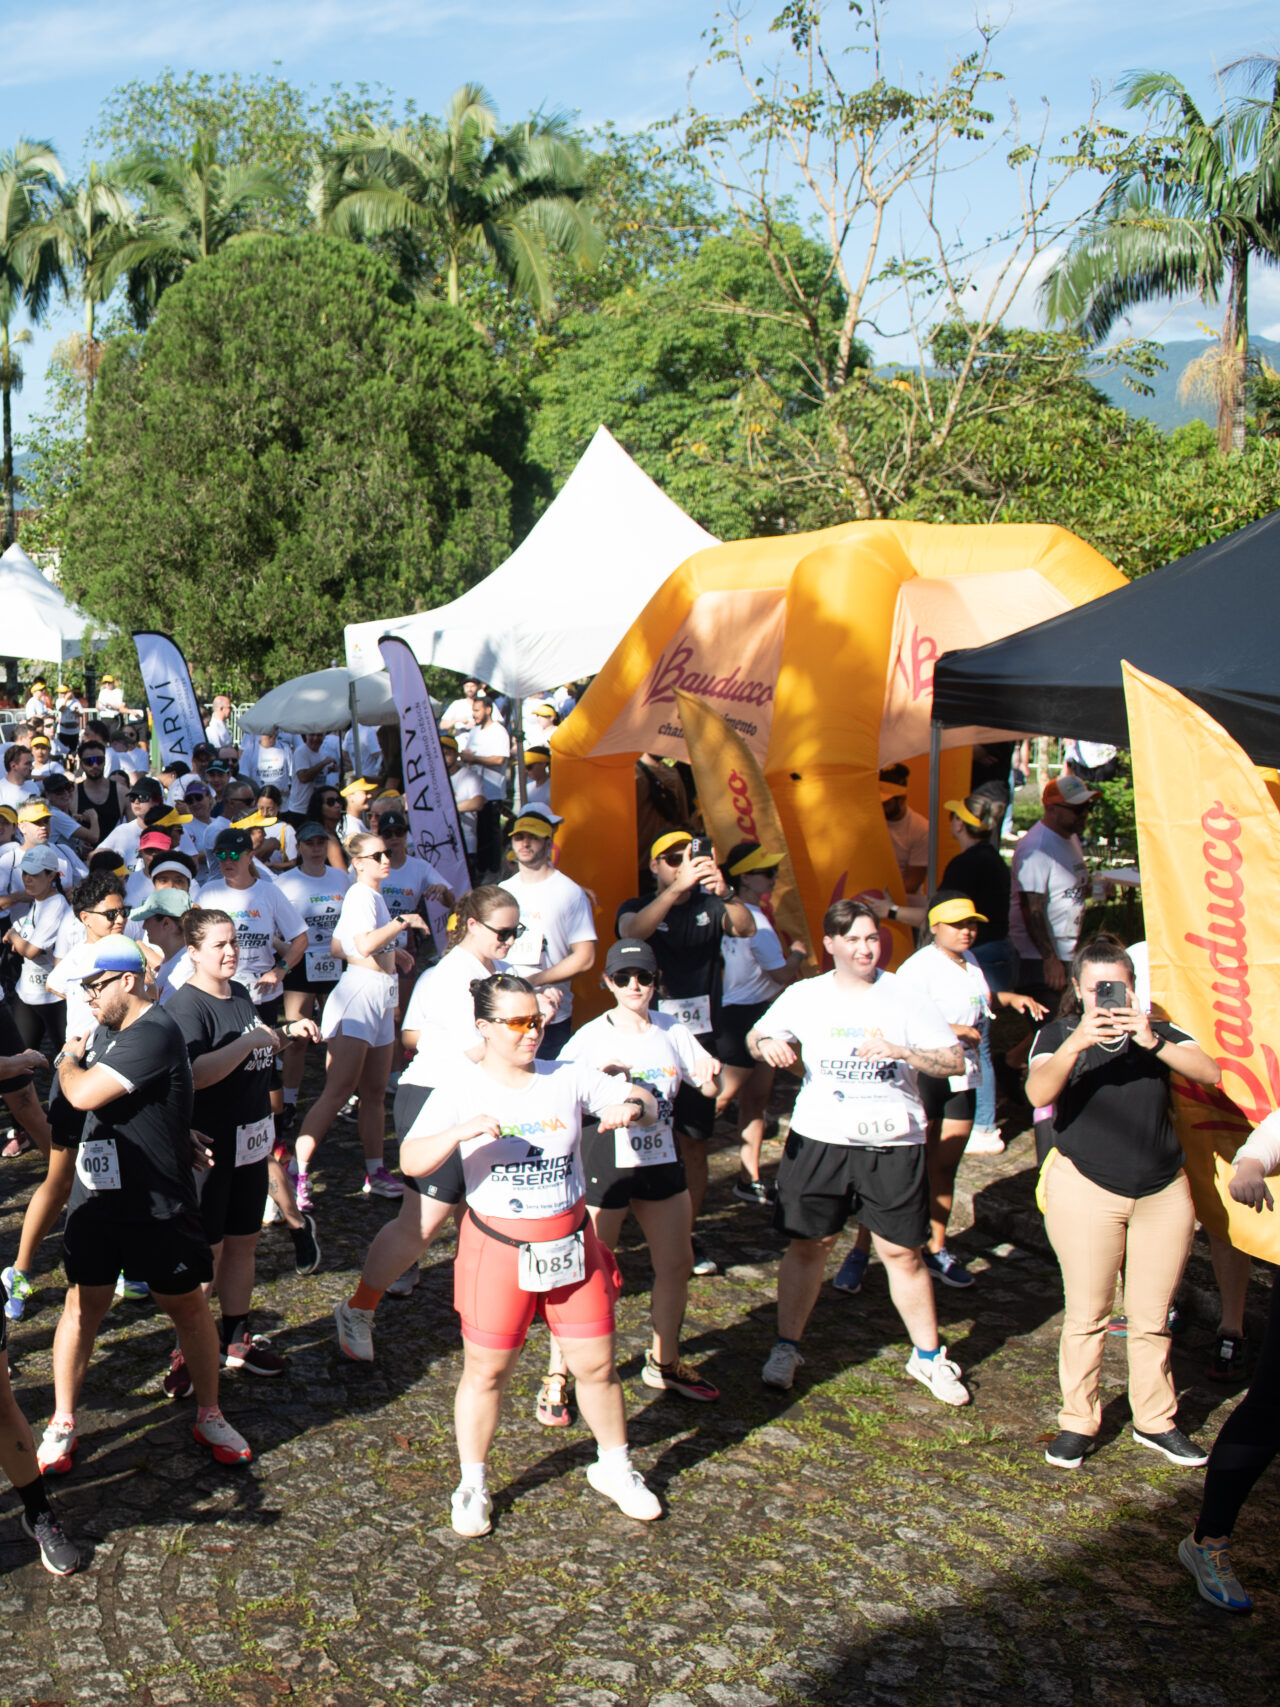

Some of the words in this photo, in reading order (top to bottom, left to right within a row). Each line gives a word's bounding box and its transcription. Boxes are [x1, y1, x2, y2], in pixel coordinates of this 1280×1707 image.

[641, 636, 774, 707] Bauducco
[236, 933, 270, 941] RRIDA
[314, 962, 335, 972] 469
[820, 1059, 898, 1071] CORRIDA
[836, 1069, 896, 1081] SERRA
[857, 1119, 895, 1136] 016
[247, 1128, 269, 1151] 004
[631, 1133, 663, 1151] 086
[84, 1156, 109, 1173] 003
[491, 1152, 574, 1174] CORRIDA
[512, 1164, 573, 1186] SERRA
[536, 1252, 573, 1275] 085
